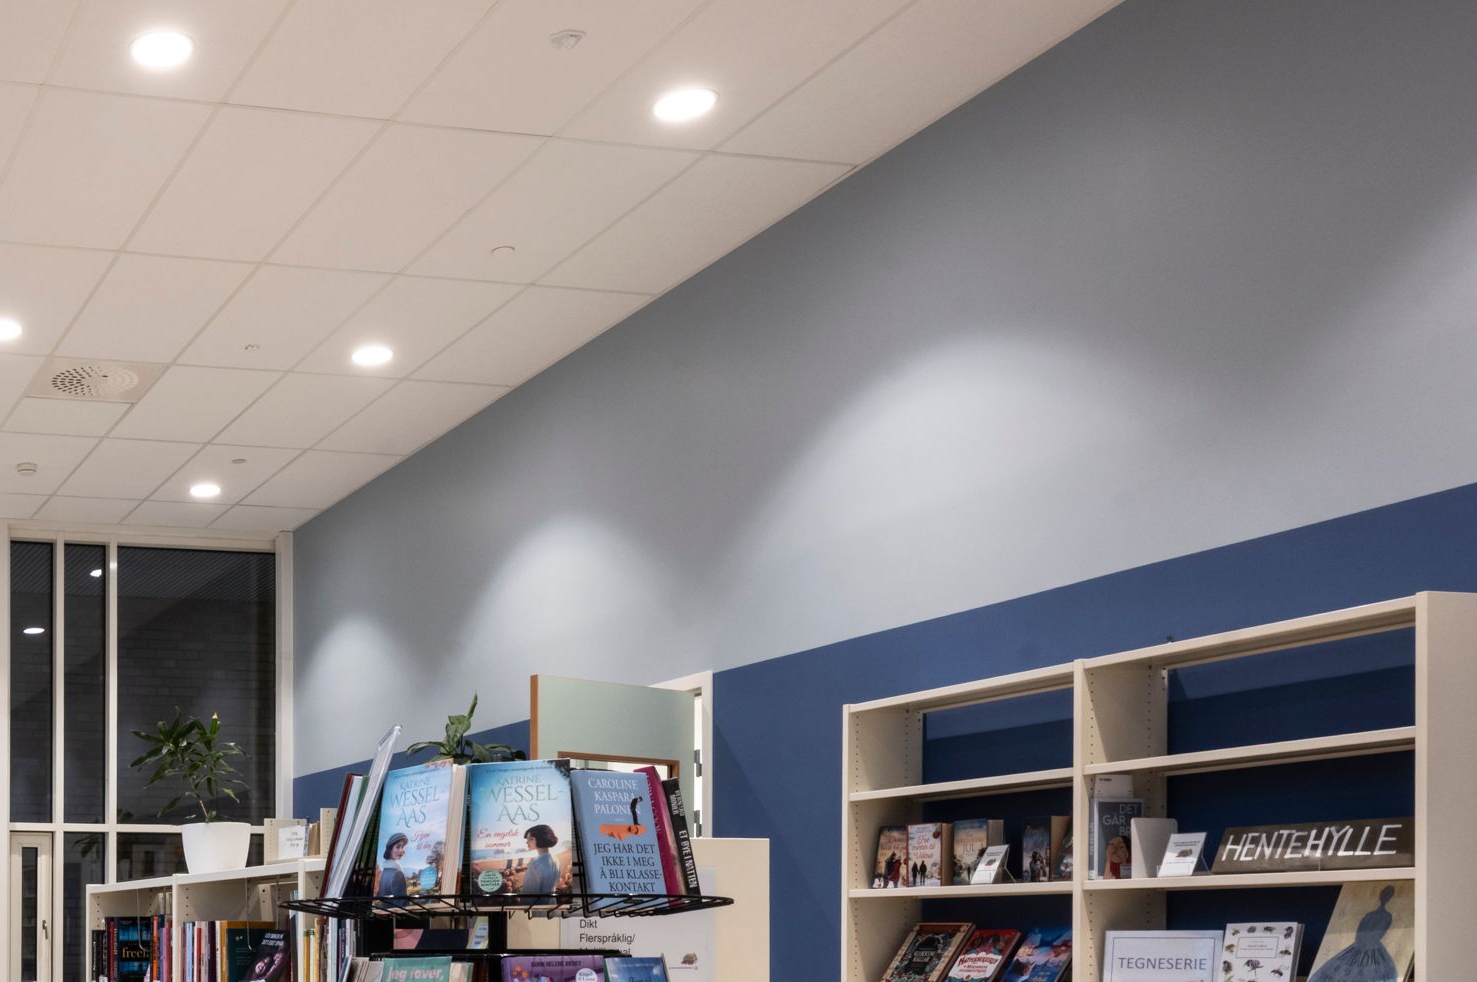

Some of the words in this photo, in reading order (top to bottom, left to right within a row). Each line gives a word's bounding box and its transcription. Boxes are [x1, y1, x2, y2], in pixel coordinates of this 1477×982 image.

[587, 778, 640, 790] CAROLINE
[594, 791, 635, 801] KASPARA
[497, 803, 540, 825] AAS
[1119, 804, 1139, 814] DET
[396, 805, 427, 828] AAS
[1102, 812, 1126, 826] GÅR
[1221, 824, 1403, 861] HENTEHYLLE
[593, 844, 611, 855] JEG
[613, 844, 634, 854] HAR
[636, 844, 655, 854] DET
[601, 856, 625, 866] IKKE
[626, 857, 631, 867] I
[632, 857, 655, 867] MEG
[600, 868, 607, 879] Å
[609, 869, 624, 879] BLI
[627, 869, 663, 879] KLASSE-
[609, 882, 656, 892] KONTAKT
[579, 919, 598, 929] Dikt
[579, 933, 636, 945] Flerspråklig/
[1117, 957, 1207, 970] TEGNESERIE
[386, 966, 407, 982] jeg
[410, 967, 444, 980] lover,
